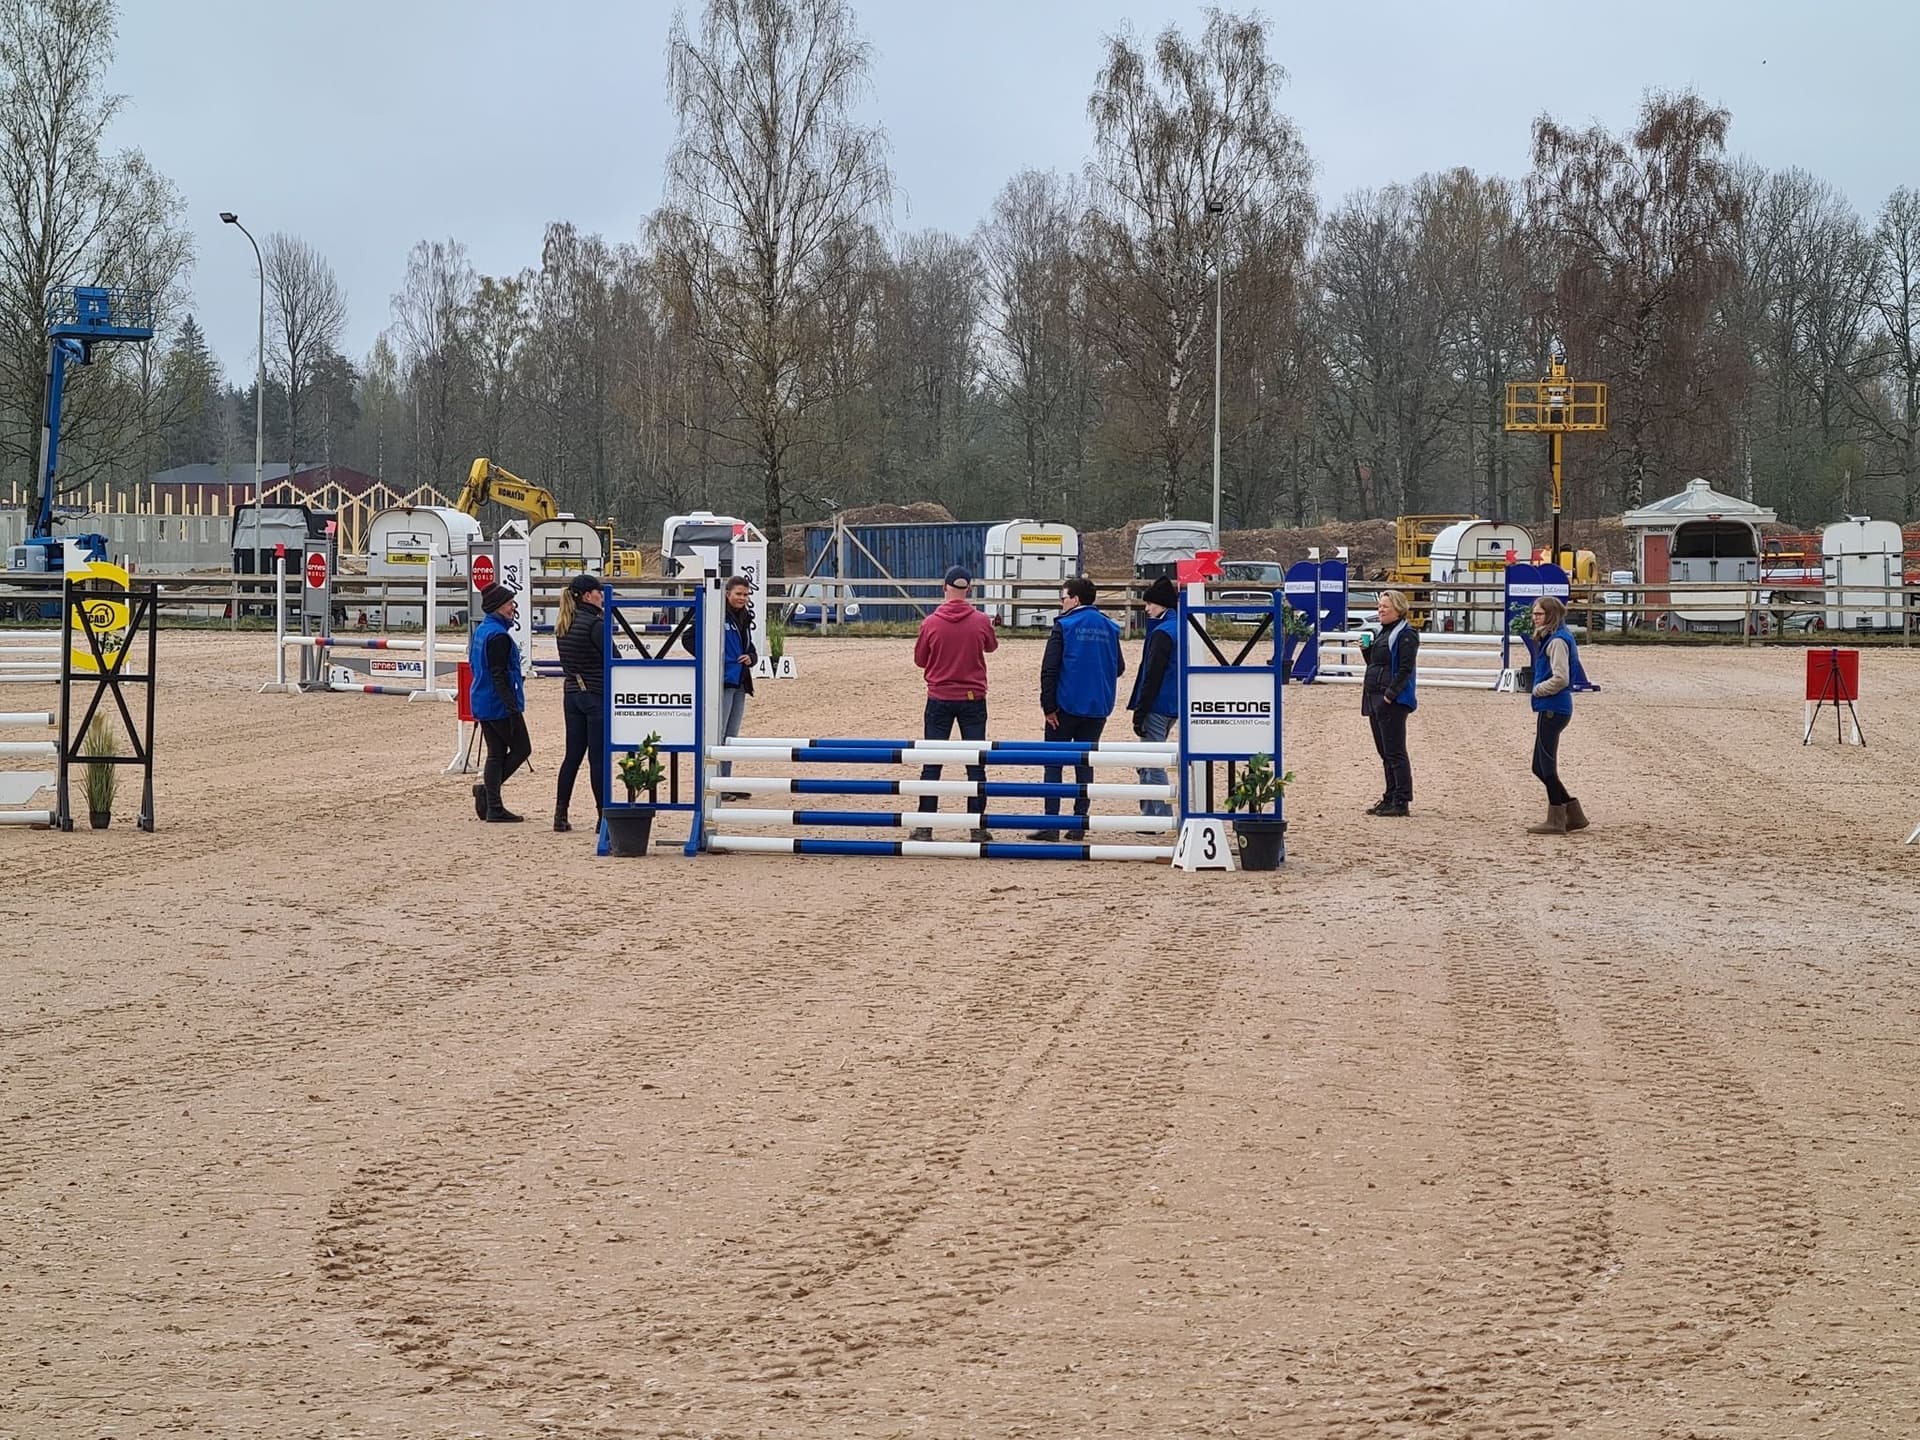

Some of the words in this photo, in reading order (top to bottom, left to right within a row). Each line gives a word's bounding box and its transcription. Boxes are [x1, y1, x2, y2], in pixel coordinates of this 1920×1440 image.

[498, 488, 525, 501] KOMATSU
[760, 660, 766, 675] 4
[783, 660, 790, 675] 8
[343, 670, 350, 684] 5
[1516, 672, 1525, 688] 10
[614, 693, 692, 705] ABETONG
[1191, 701, 1271, 713] ABETONG
[1203, 827, 1217, 860] 3
